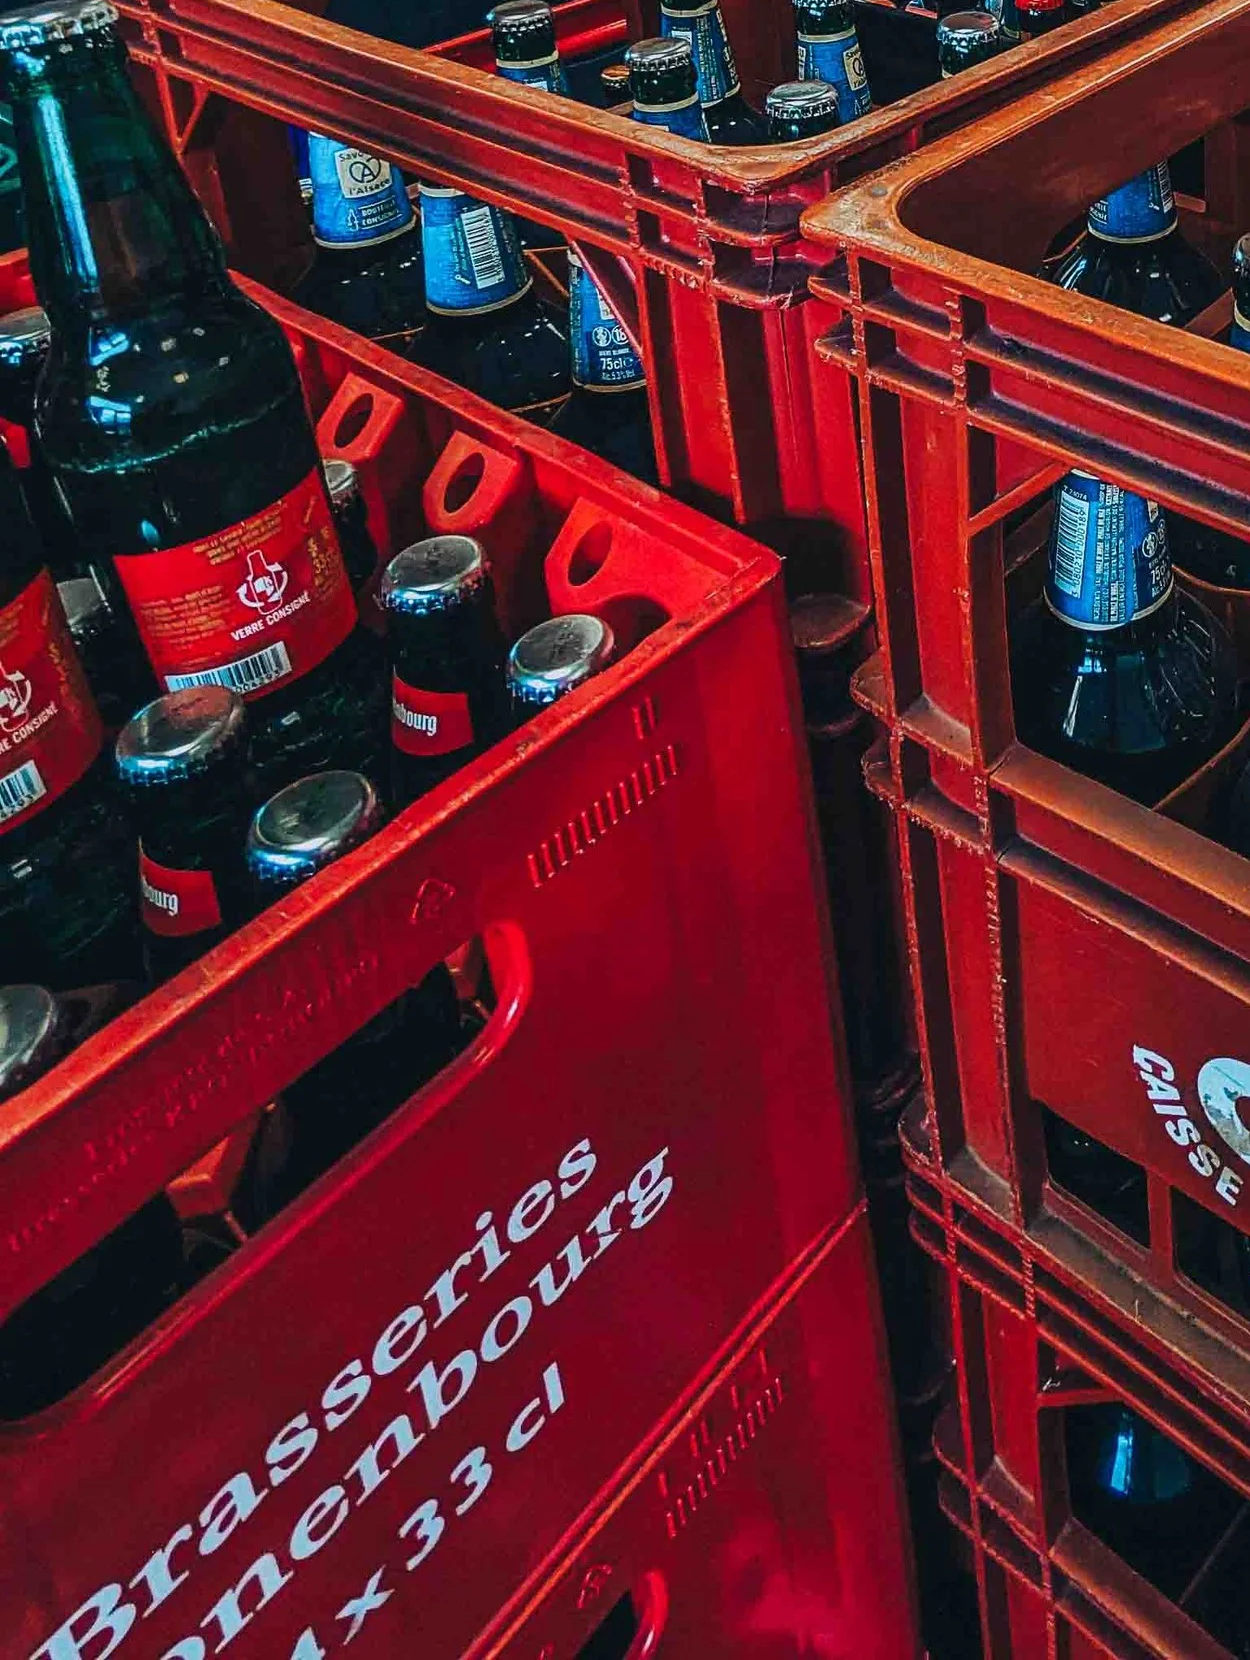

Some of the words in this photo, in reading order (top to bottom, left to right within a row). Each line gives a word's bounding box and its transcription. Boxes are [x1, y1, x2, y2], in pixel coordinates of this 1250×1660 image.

[600, 357, 623, 370] 75cl
[231, 620, 264, 642] VERRE
[1132, 1044, 1245, 1207] CAISSE
[28, 1137, 599, 1660] Brasseries
[335, 1564, 396, 1646] x
[399, 1442, 496, 1572] 33
[504, 1360, 567, 1454] cl
